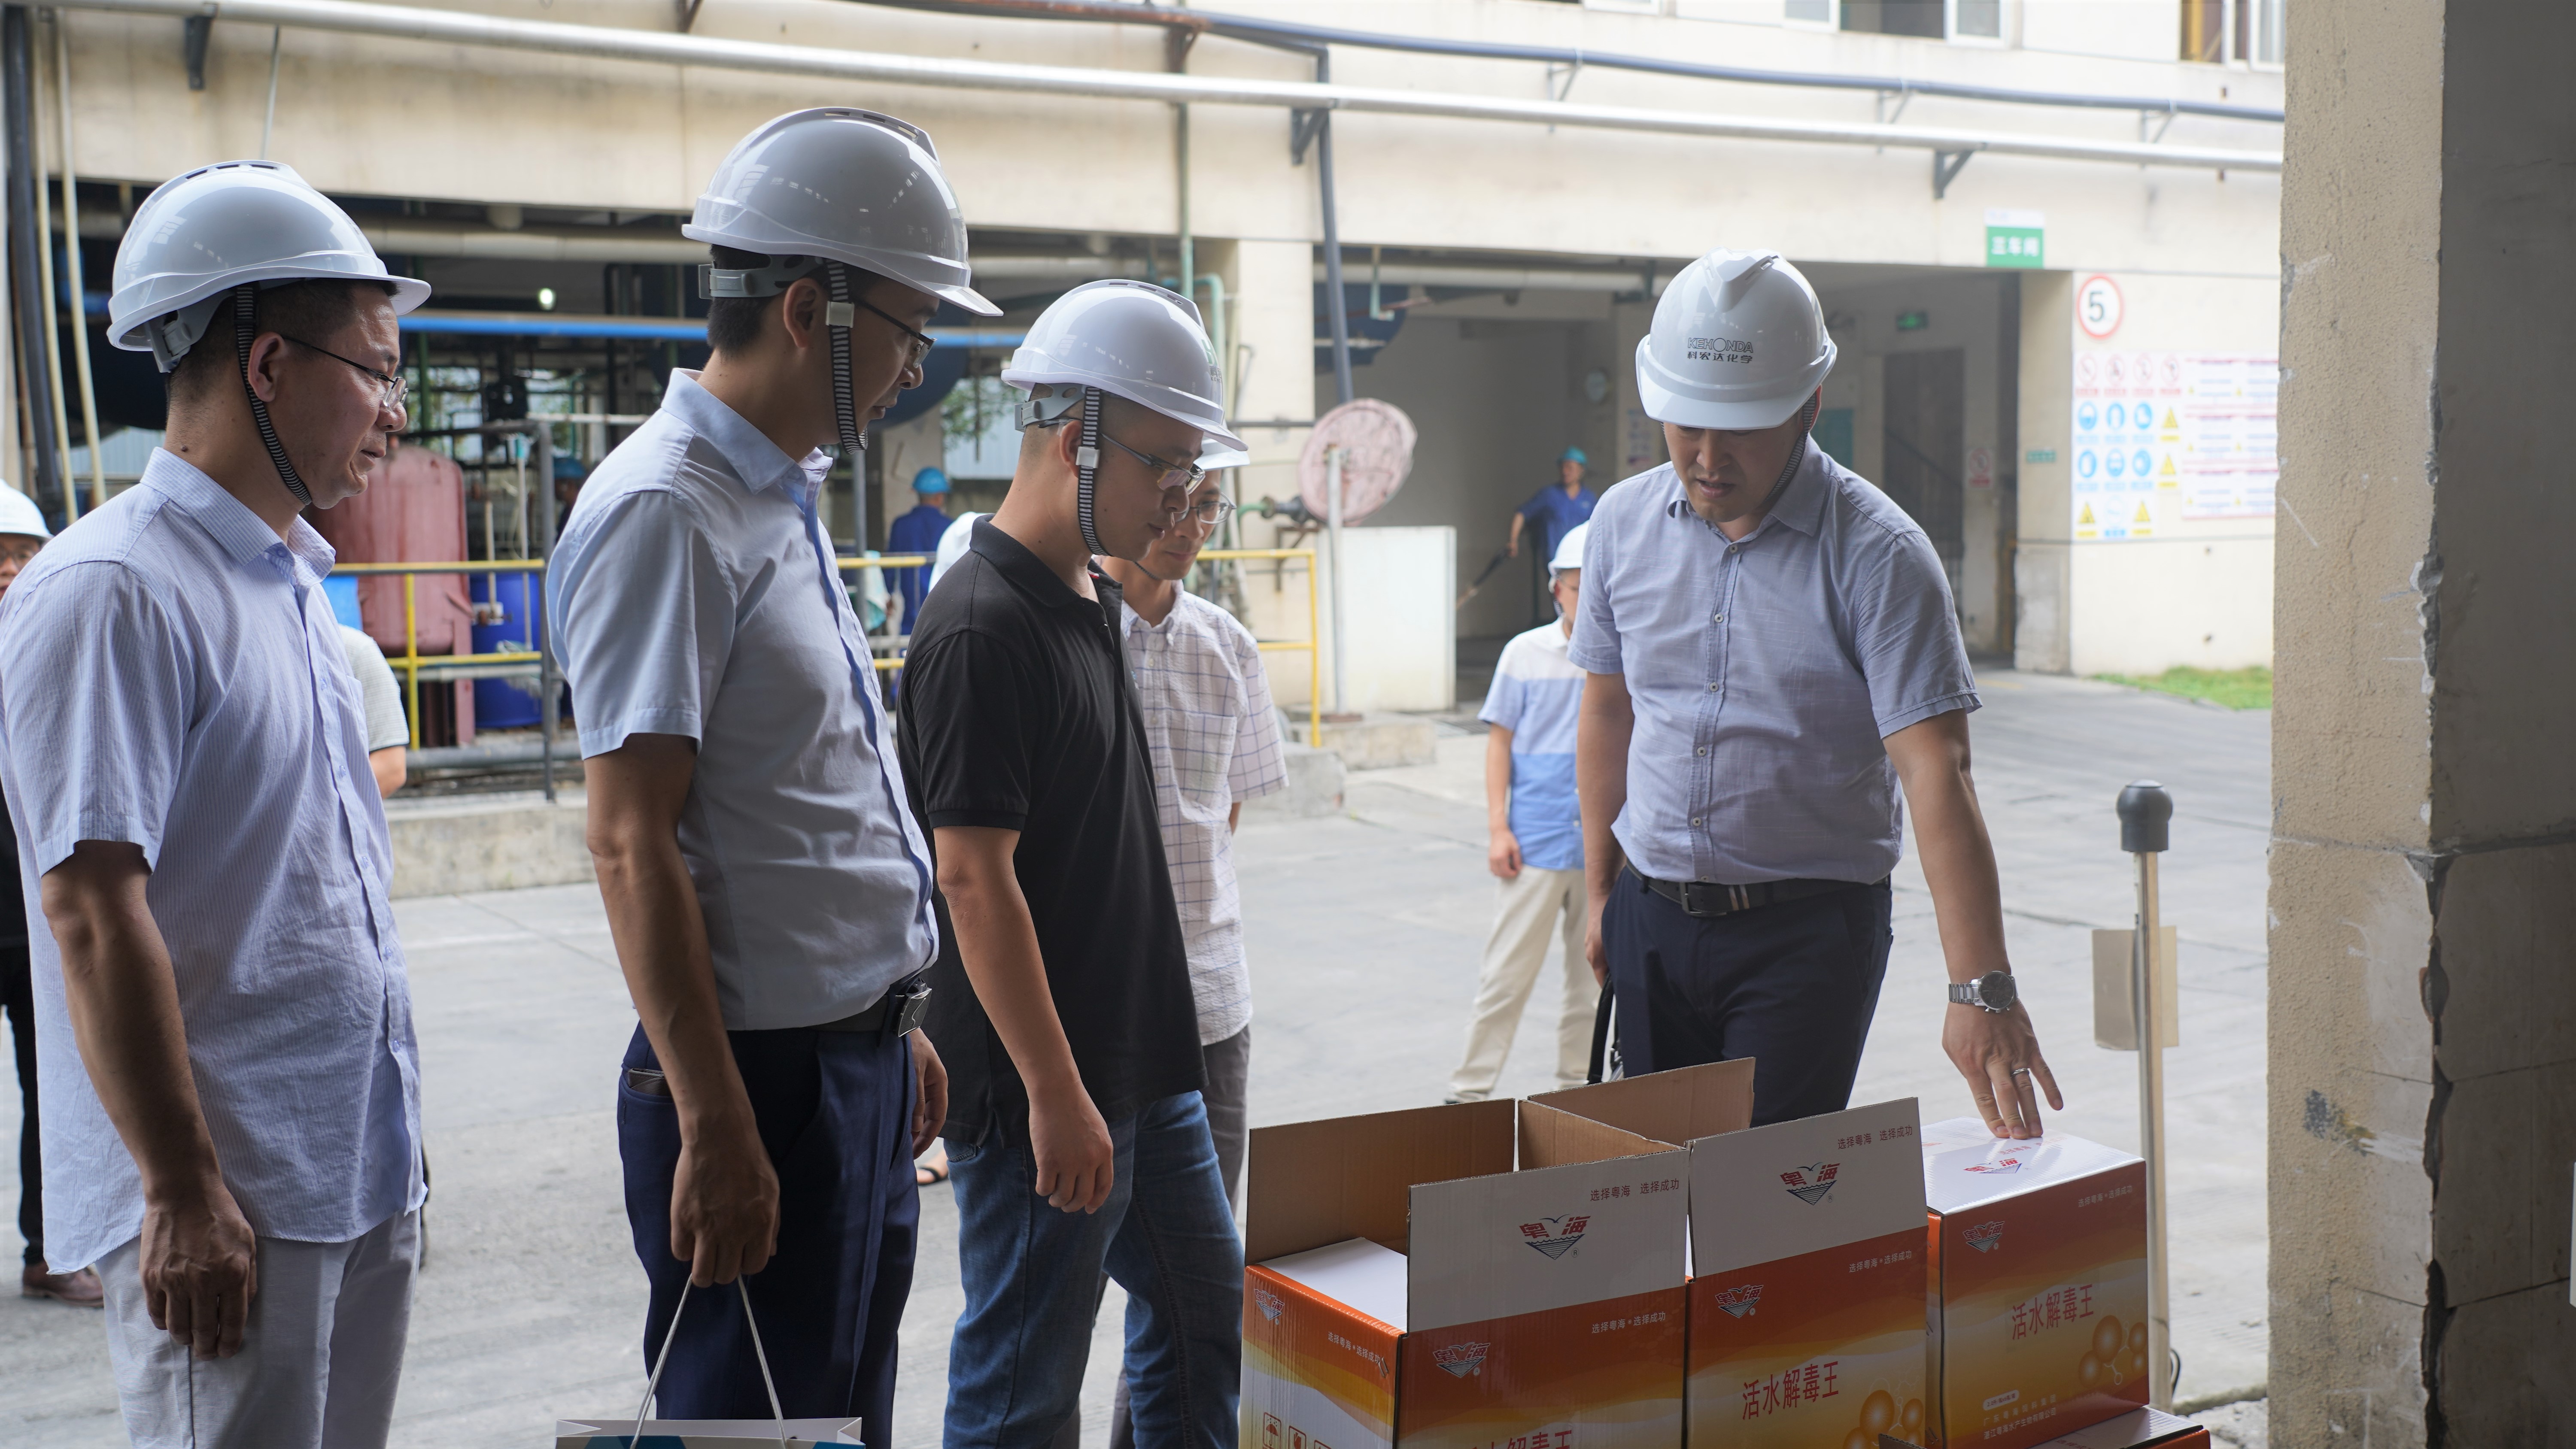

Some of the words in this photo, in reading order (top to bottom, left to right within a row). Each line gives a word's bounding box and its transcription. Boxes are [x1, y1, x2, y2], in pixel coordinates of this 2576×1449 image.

[2089, 290, 2105, 322] 5
[1688, 337, 1753, 353] KEHONDA
[1687, 351, 1753, 364] 科宏达化学
[1838, 1133, 1872, 1150] 选择粤海
[1879, 1125, 1913, 1141] 选择成功
[1780, 1162, 1841, 1186] 粤海
[1590, 1185, 1631, 1201] 选择粤海
[1640, 1178, 1680, 1194] 选择成功
[1519, 1216, 1591, 1239] 粤海
[1714, 1284, 1764, 1305] 粤海
[2012, 1284, 2094, 1340] 活水解毒王
[1432, 1342, 1491, 1362] 粤海
[1742, 1361, 1839, 1420] 活水解毒王
[1984, 1407, 2057, 1440] 湛江粤海水产生物有限公司
